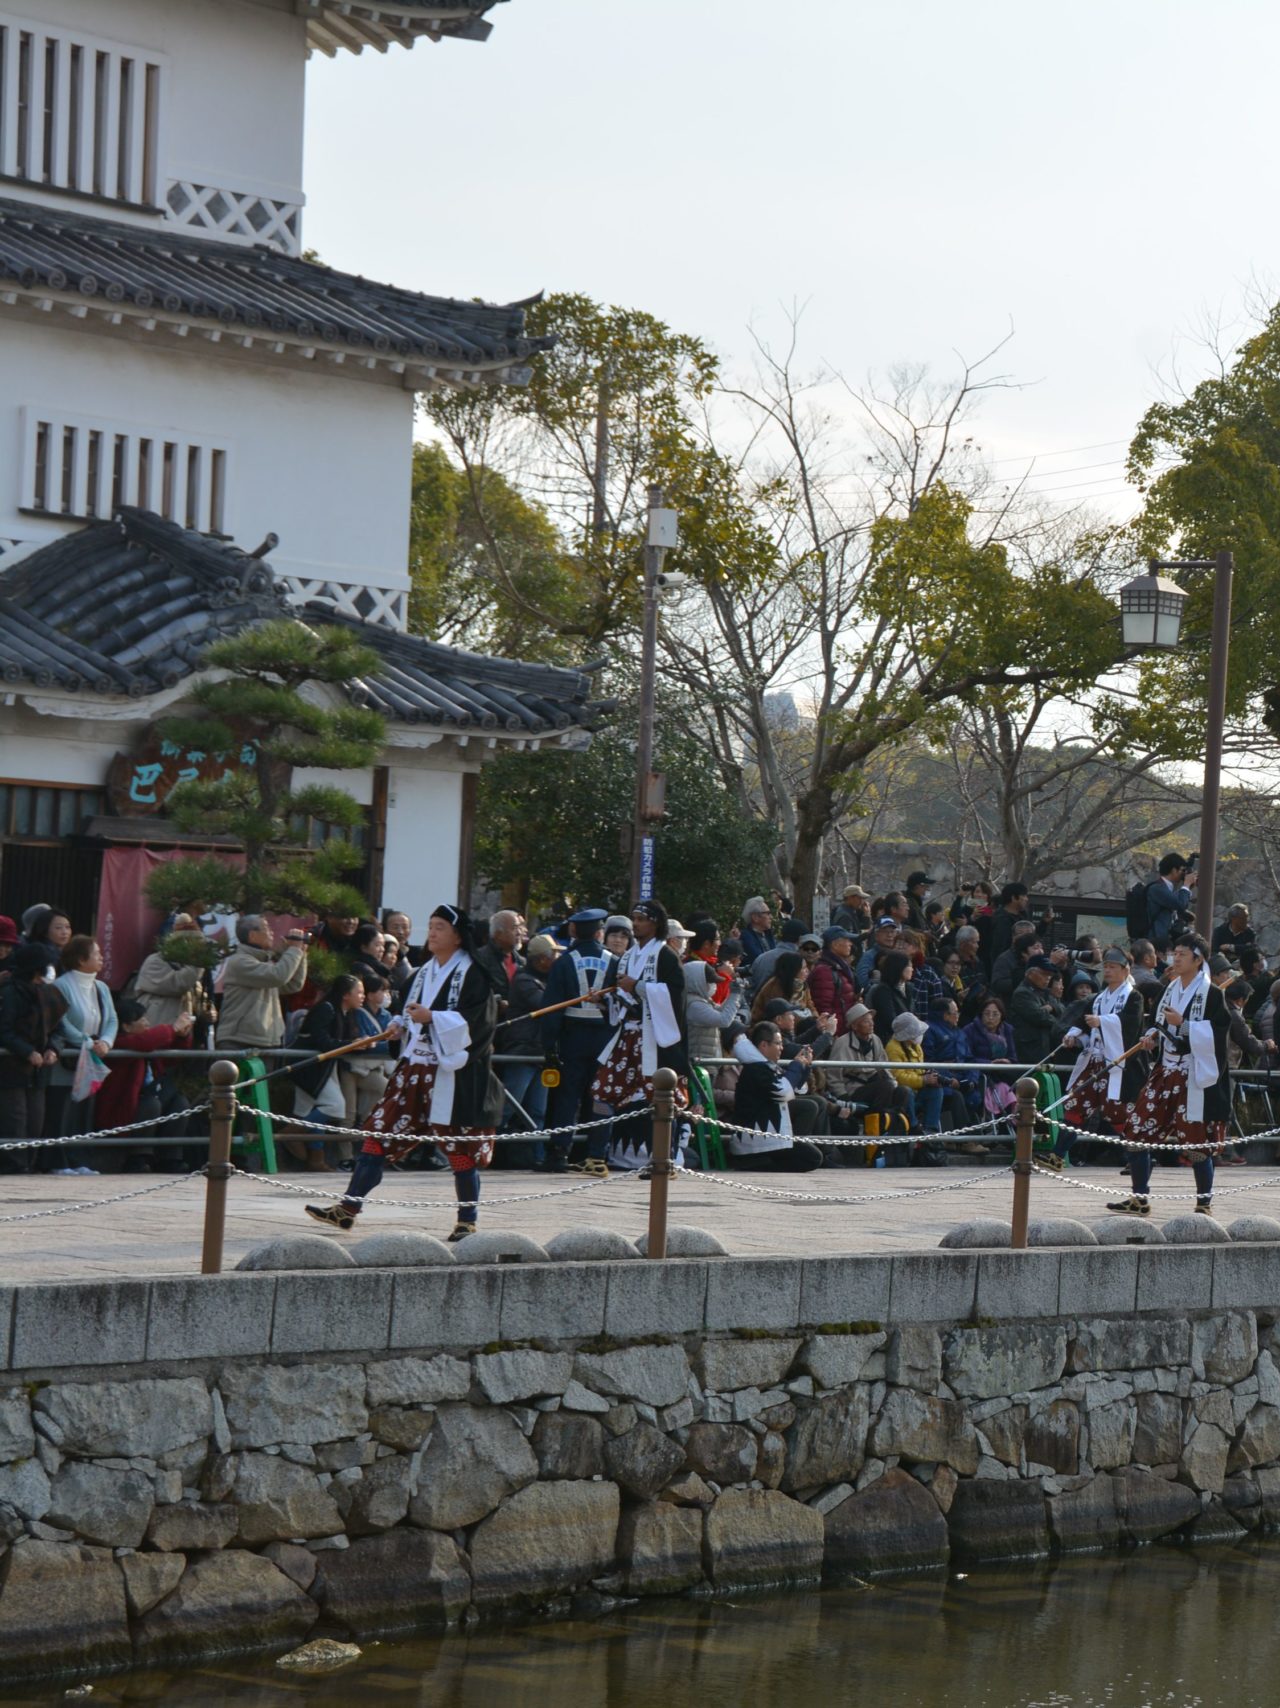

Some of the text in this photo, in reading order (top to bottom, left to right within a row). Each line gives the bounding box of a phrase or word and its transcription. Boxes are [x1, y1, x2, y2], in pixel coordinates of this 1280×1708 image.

[641, 838, 653, 899] 防犯カメラ作動中
[1191, 993, 1203, 1021] 播州
